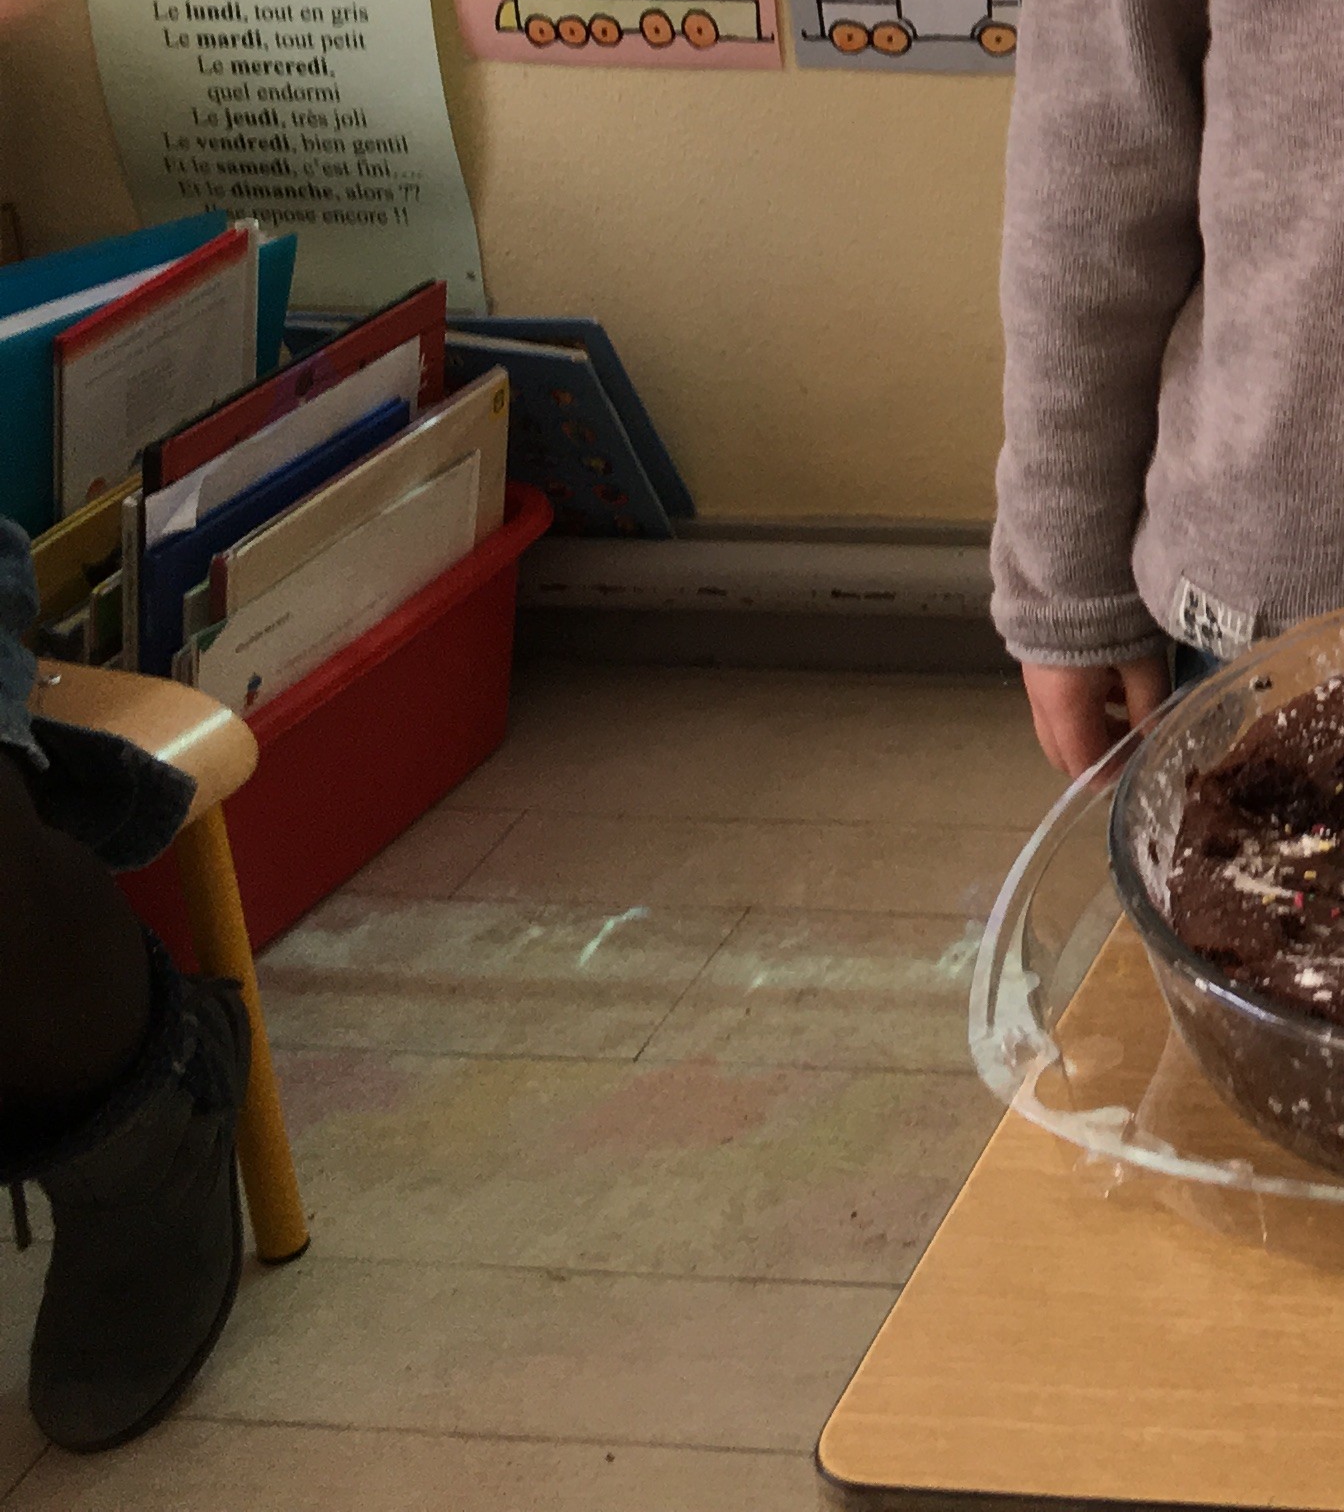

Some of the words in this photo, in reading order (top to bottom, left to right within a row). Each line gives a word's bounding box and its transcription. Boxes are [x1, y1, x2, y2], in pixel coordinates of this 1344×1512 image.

[153, 1, 178, 21] Le
[185, 1, 248, 23] lundi,
[255, 5, 293, 22] tout
[300, 8, 323, 22] en
[331, 2, 368, 28] gris
[163, 29, 189, 48] Le
[197, 29, 268, 51] mardi,
[275, 31, 313, 49] tout
[321, 30, 365, 54] petit
[198, 55, 223, 75] Le
[231, 55, 335, 78] mercredi,
[207, 82, 249, 106] quel
[257, 82, 340, 104] endormi
[193, 107, 218, 126] Le
[225, 108, 285, 131] jeudi,
[292, 108, 328, 128] très
[333, 108, 368, 132] joli
[197, 133, 298, 154] vendredi,
[300, 132, 345, 152] bien
[353, 133, 408, 156] gentil
[216, 157, 299, 177] samedi,
[231, 180, 340, 202] dimanche,
[345, 182, 394, 202] alors
[252, 207, 316, 228] repose
[322, 208, 388, 225] encore
